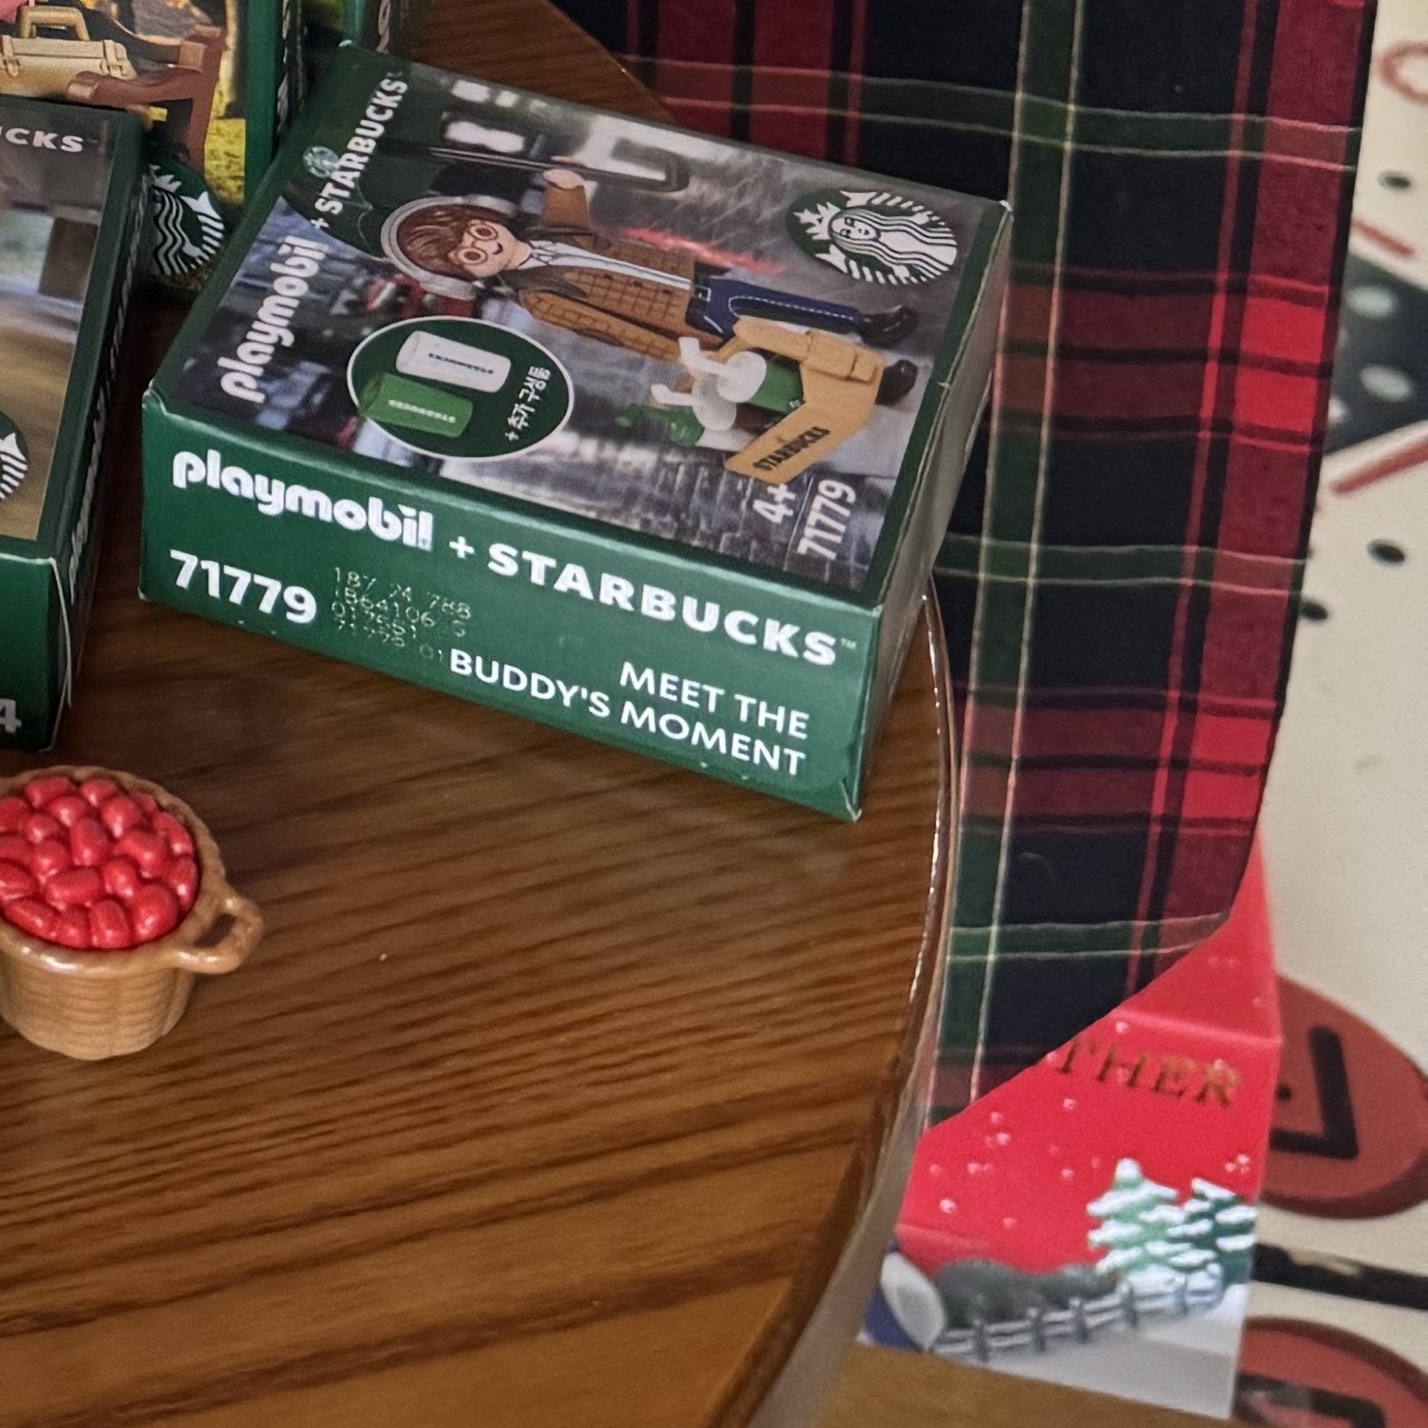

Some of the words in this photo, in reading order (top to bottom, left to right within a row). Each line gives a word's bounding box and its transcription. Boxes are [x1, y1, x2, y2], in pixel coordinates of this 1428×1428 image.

[217, 235, 331, 404] playmobil
[752, 484, 797, 526] 4+
[797, 479, 857, 561] 71779
[169, 548, 317, 625] 71779
[448, 647, 611, 719] BUDDY'S
[620, 701, 806, 777] MOMENT
[619, 661, 725, 715] MEET
[732, 694, 809, 741] THE
